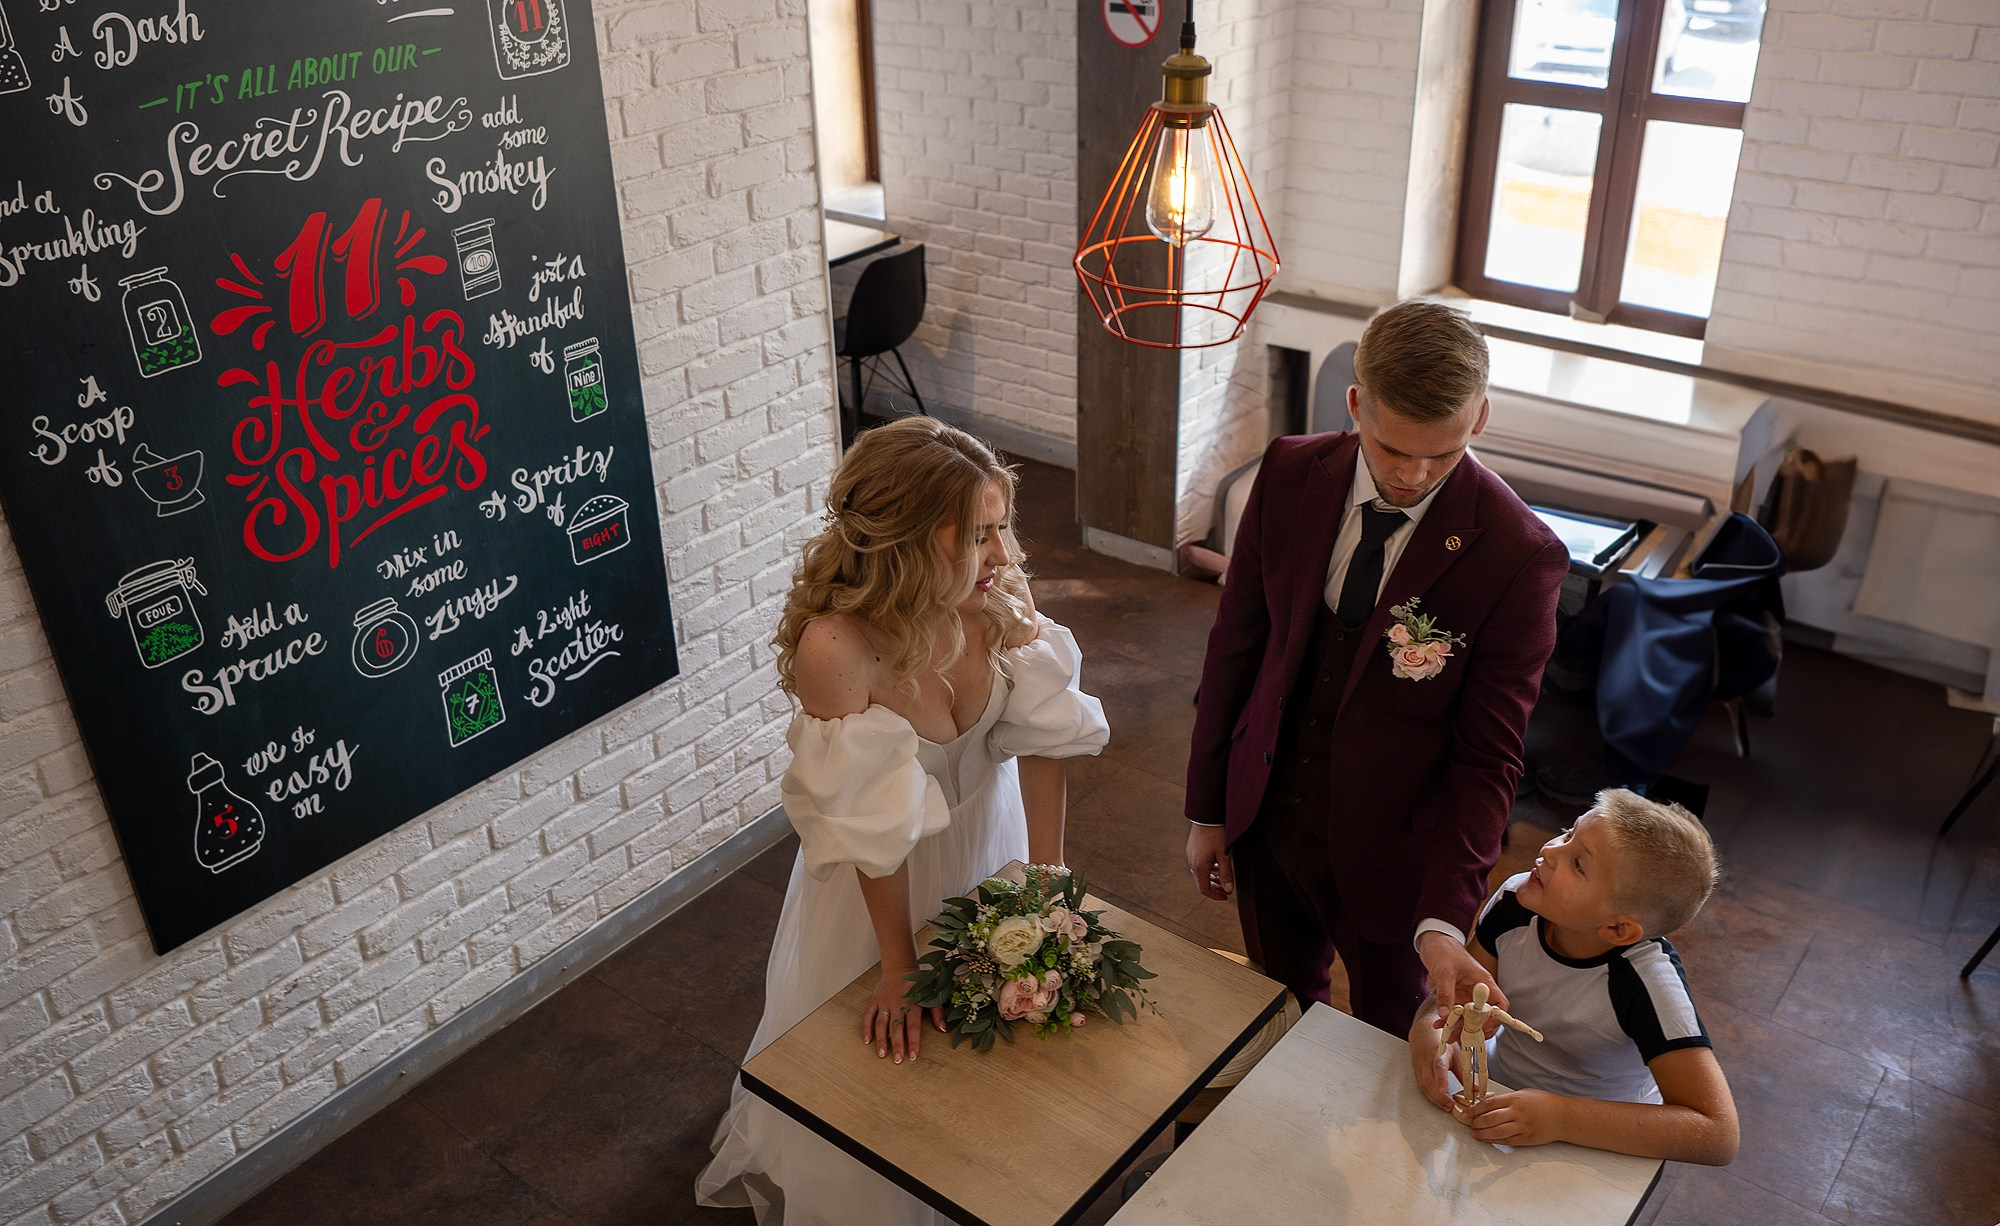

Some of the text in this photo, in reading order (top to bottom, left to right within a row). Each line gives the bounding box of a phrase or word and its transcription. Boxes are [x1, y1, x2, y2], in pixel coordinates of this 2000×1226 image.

[52, 0, 205, 69] A Dash
[515, 0, 544, 32] 11
[176, 44, 418, 113] IT'S ALL ABOUT OUR
[46, 76, 88, 126] of
[481, 94, 523, 128] add
[94, 89, 473, 215] Secret Recipe
[498, 126, 548, 150] some
[35, 190, 60, 213] a
[67, 263, 101, 302] of
[274, 198, 388, 338] 11
[470, 254, 488, 269] 10
[529, 253, 567, 302] just
[147, 305, 172, 338] 2
[483, 285, 584, 349] Handful
[529, 337, 555, 374] of
[77, 375, 107, 408] A
[232, 310, 475, 465] Herbs
[573, 370, 596, 388] Nine
[29, 406, 135, 465] Scoop
[350, 402, 410, 451] &
[85, 448, 123, 487] of
[164, 465, 183, 491] 3
[243, 394, 491, 569] Spices
[479, 445, 614, 521] A Spritz
[546, 491, 566, 527] of
[377, 530, 462, 579] Mix in
[582, 523, 620, 550] EIGHT
[405, 560, 468, 597] some
[145, 601, 176, 623] FOUR
[221, 602, 309, 650] Add a
[425, 575, 518, 641] Zingy
[511, 589, 591, 656] A Light
[375, 628, 395, 658] 6
[524, 620, 624, 707] Scatter
[182, 632, 328, 715] Spruce
[465, 693, 480, 715] 7
[242, 726, 316, 776] we go
[266, 739, 360, 790] easy
[214, 805, 239, 839] 5
[292, 793, 325, 819] on
